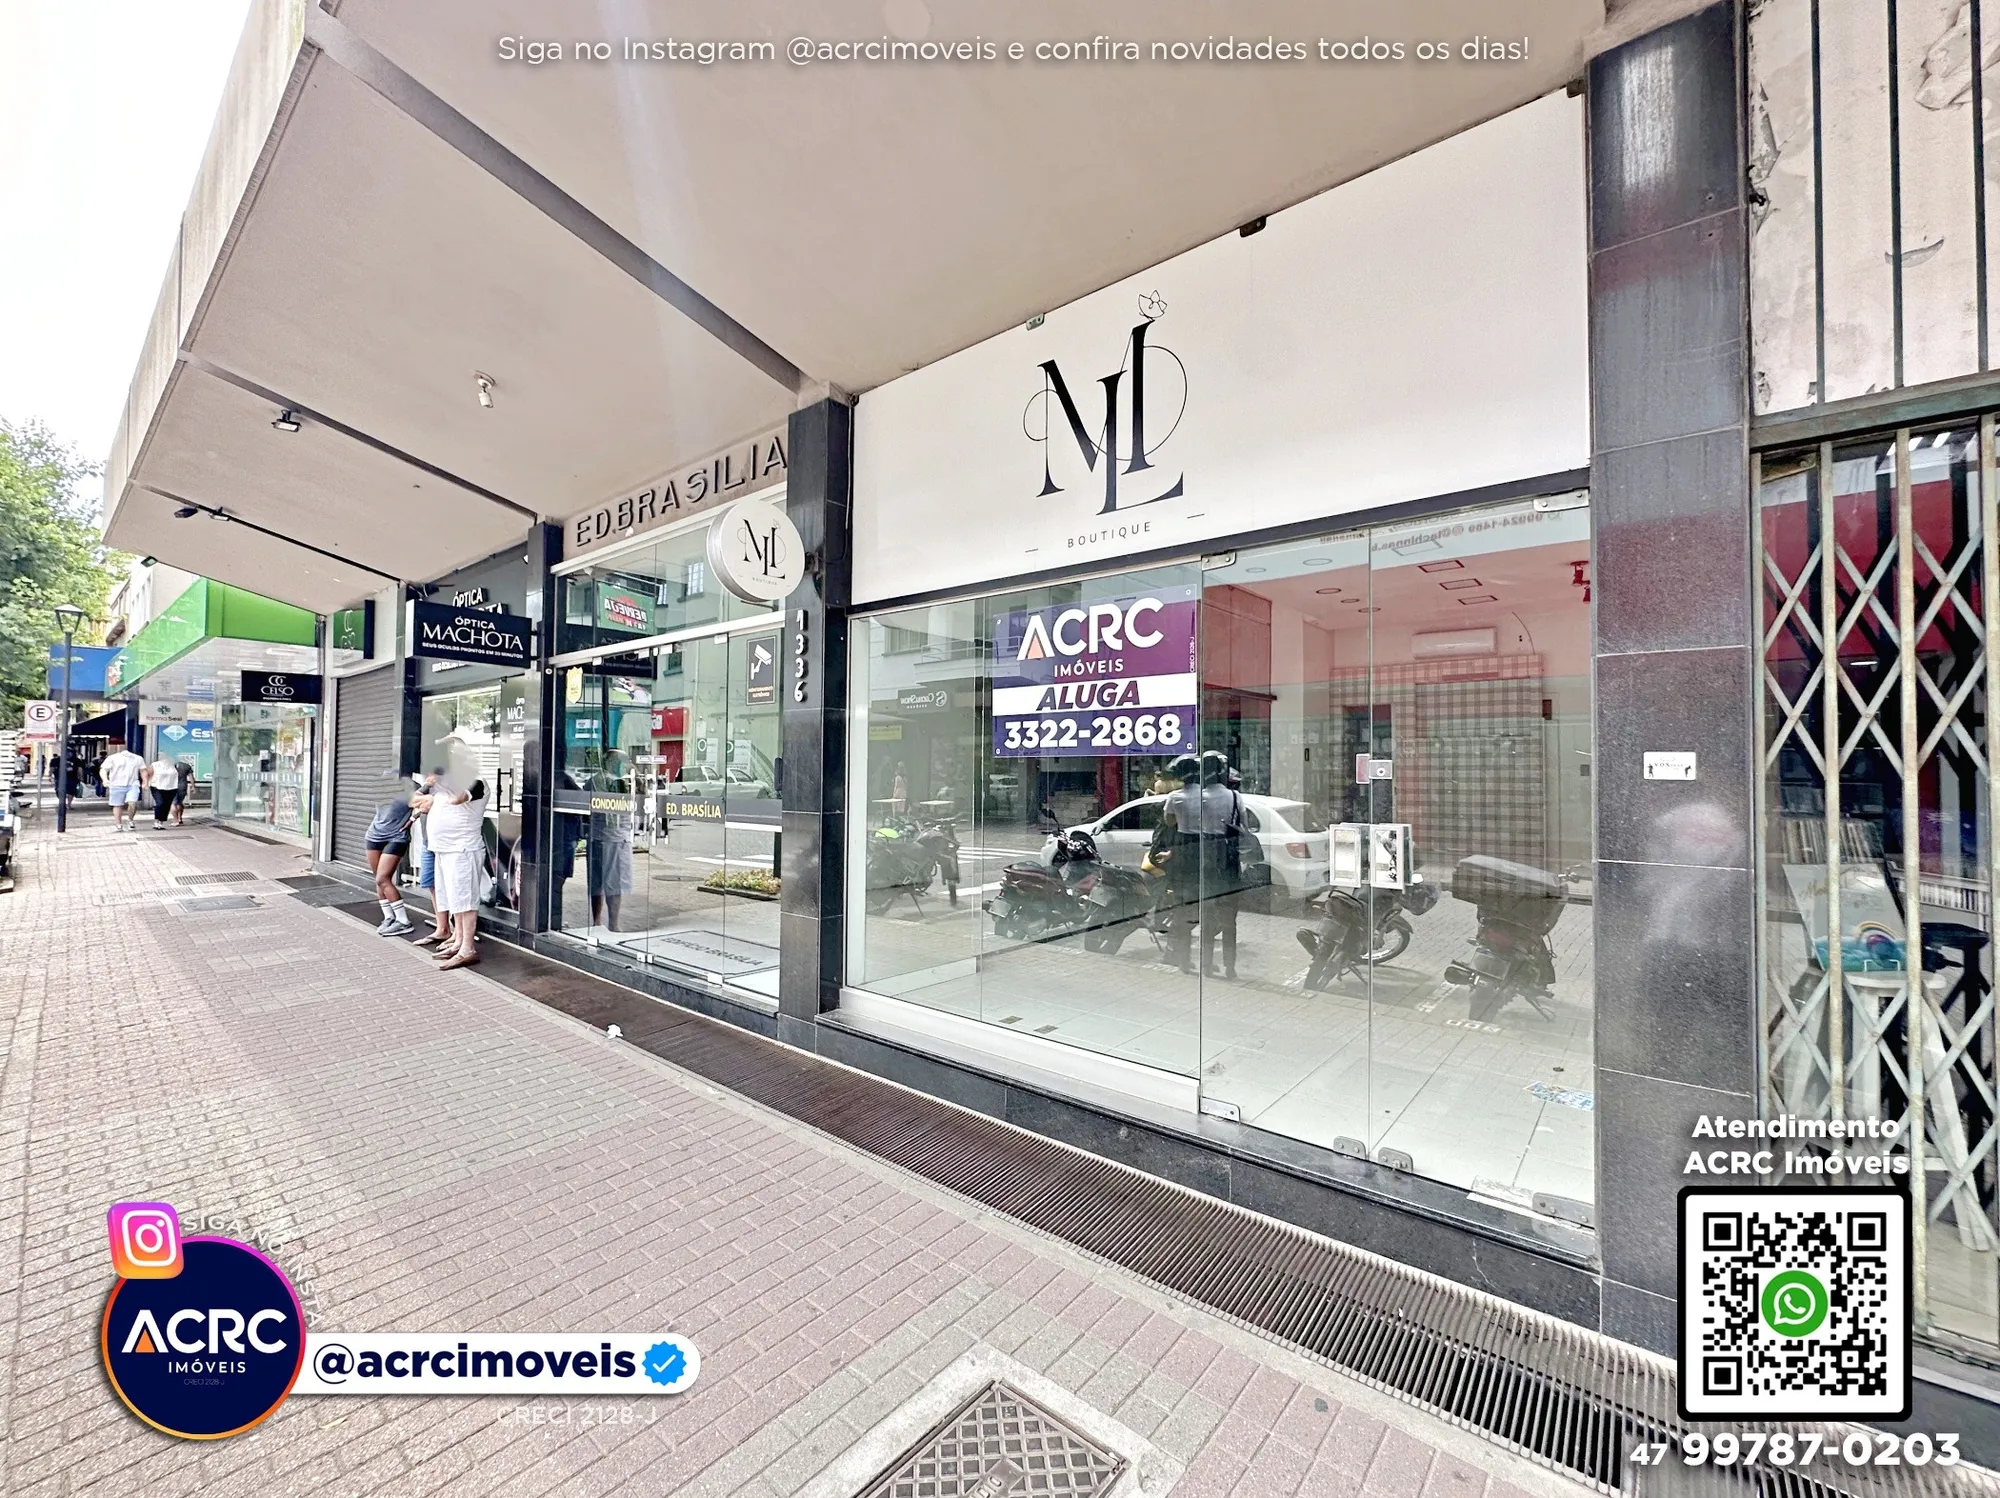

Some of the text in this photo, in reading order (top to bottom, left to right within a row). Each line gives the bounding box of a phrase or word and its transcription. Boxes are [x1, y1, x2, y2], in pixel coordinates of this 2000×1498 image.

[1067, 521, 1152, 549] BOUTIQUE
[422, 622, 524, 651] MACHOTA
[455, 616, 495, 630] ÓPTICA
[1016, 597, 1165, 661] ACRC
[794, 609, 806, 702] 1336
[1053, 658, 1125, 677] IMÓVEIS
[1036, 680, 1141, 711] ALUGA
[36, 707, 46, 718] E
[1003, 713, 1182, 749] 3322-2868
[665, 802, 680, 816] ED.
[681, 800, 722, 819] BRASÍLIA
